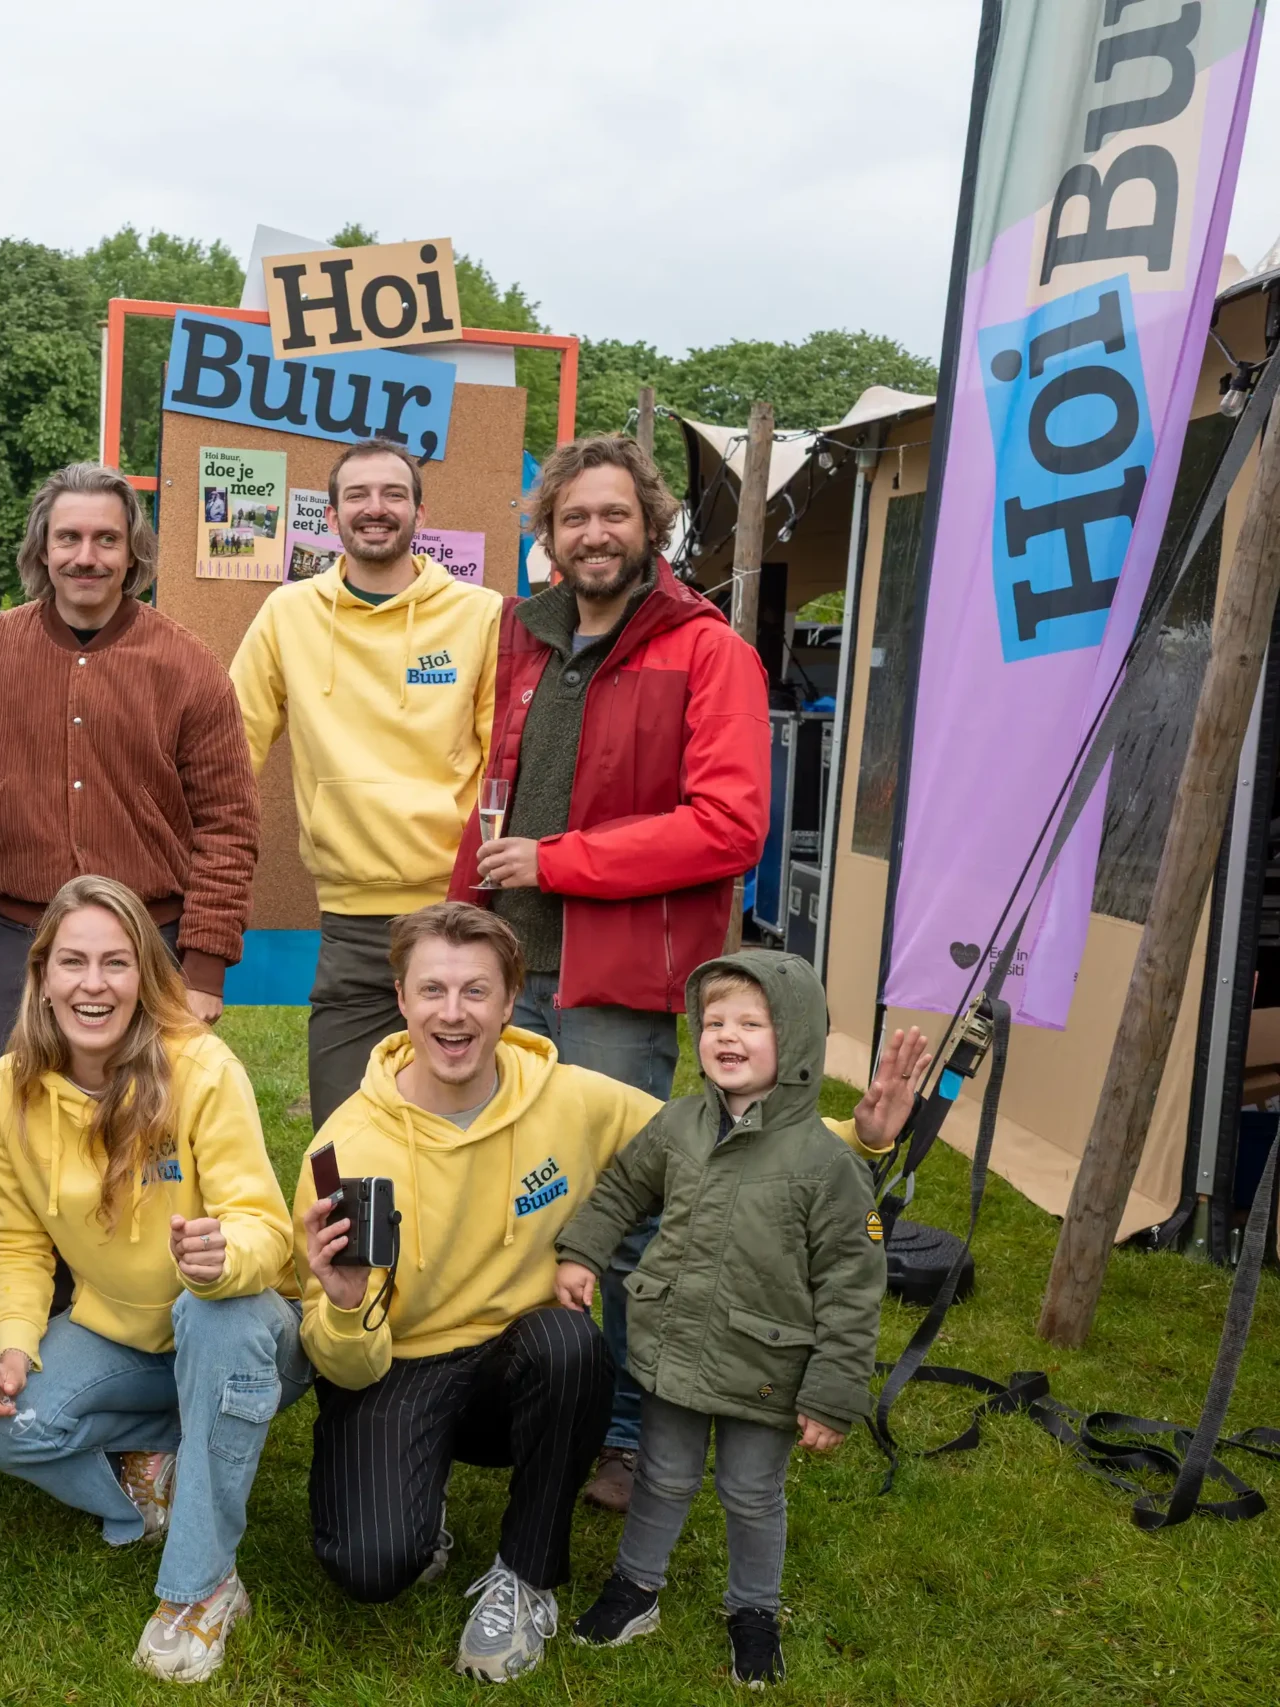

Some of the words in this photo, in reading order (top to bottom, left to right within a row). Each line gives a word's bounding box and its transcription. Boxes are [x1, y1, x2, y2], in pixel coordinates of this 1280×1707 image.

[1039, 0, 1202, 286] Bu
[273, 244, 454, 350] Hoi
[171, 318, 438, 467] Buur,
[204, 452, 219, 460] Hoi
[220, 453, 241, 462] Buur,
[990, 290, 1147, 641] Hoi
[204, 461, 235, 477] doe
[236, 463, 254, 482] je
[230, 482, 275, 497] mee?
[295, 494, 308, 502] Hoi
[292, 520, 314, 531] eet
[314, 519, 329, 535] je
[422, 533, 442, 542] Buur,
[437, 543, 453, 562] je
[417, 650, 452, 671] Hoi
[407, 669, 456, 685] Buur,
[521, 1157, 559, 1195] Hoi
[514, 1182, 569, 1216] Buur,
